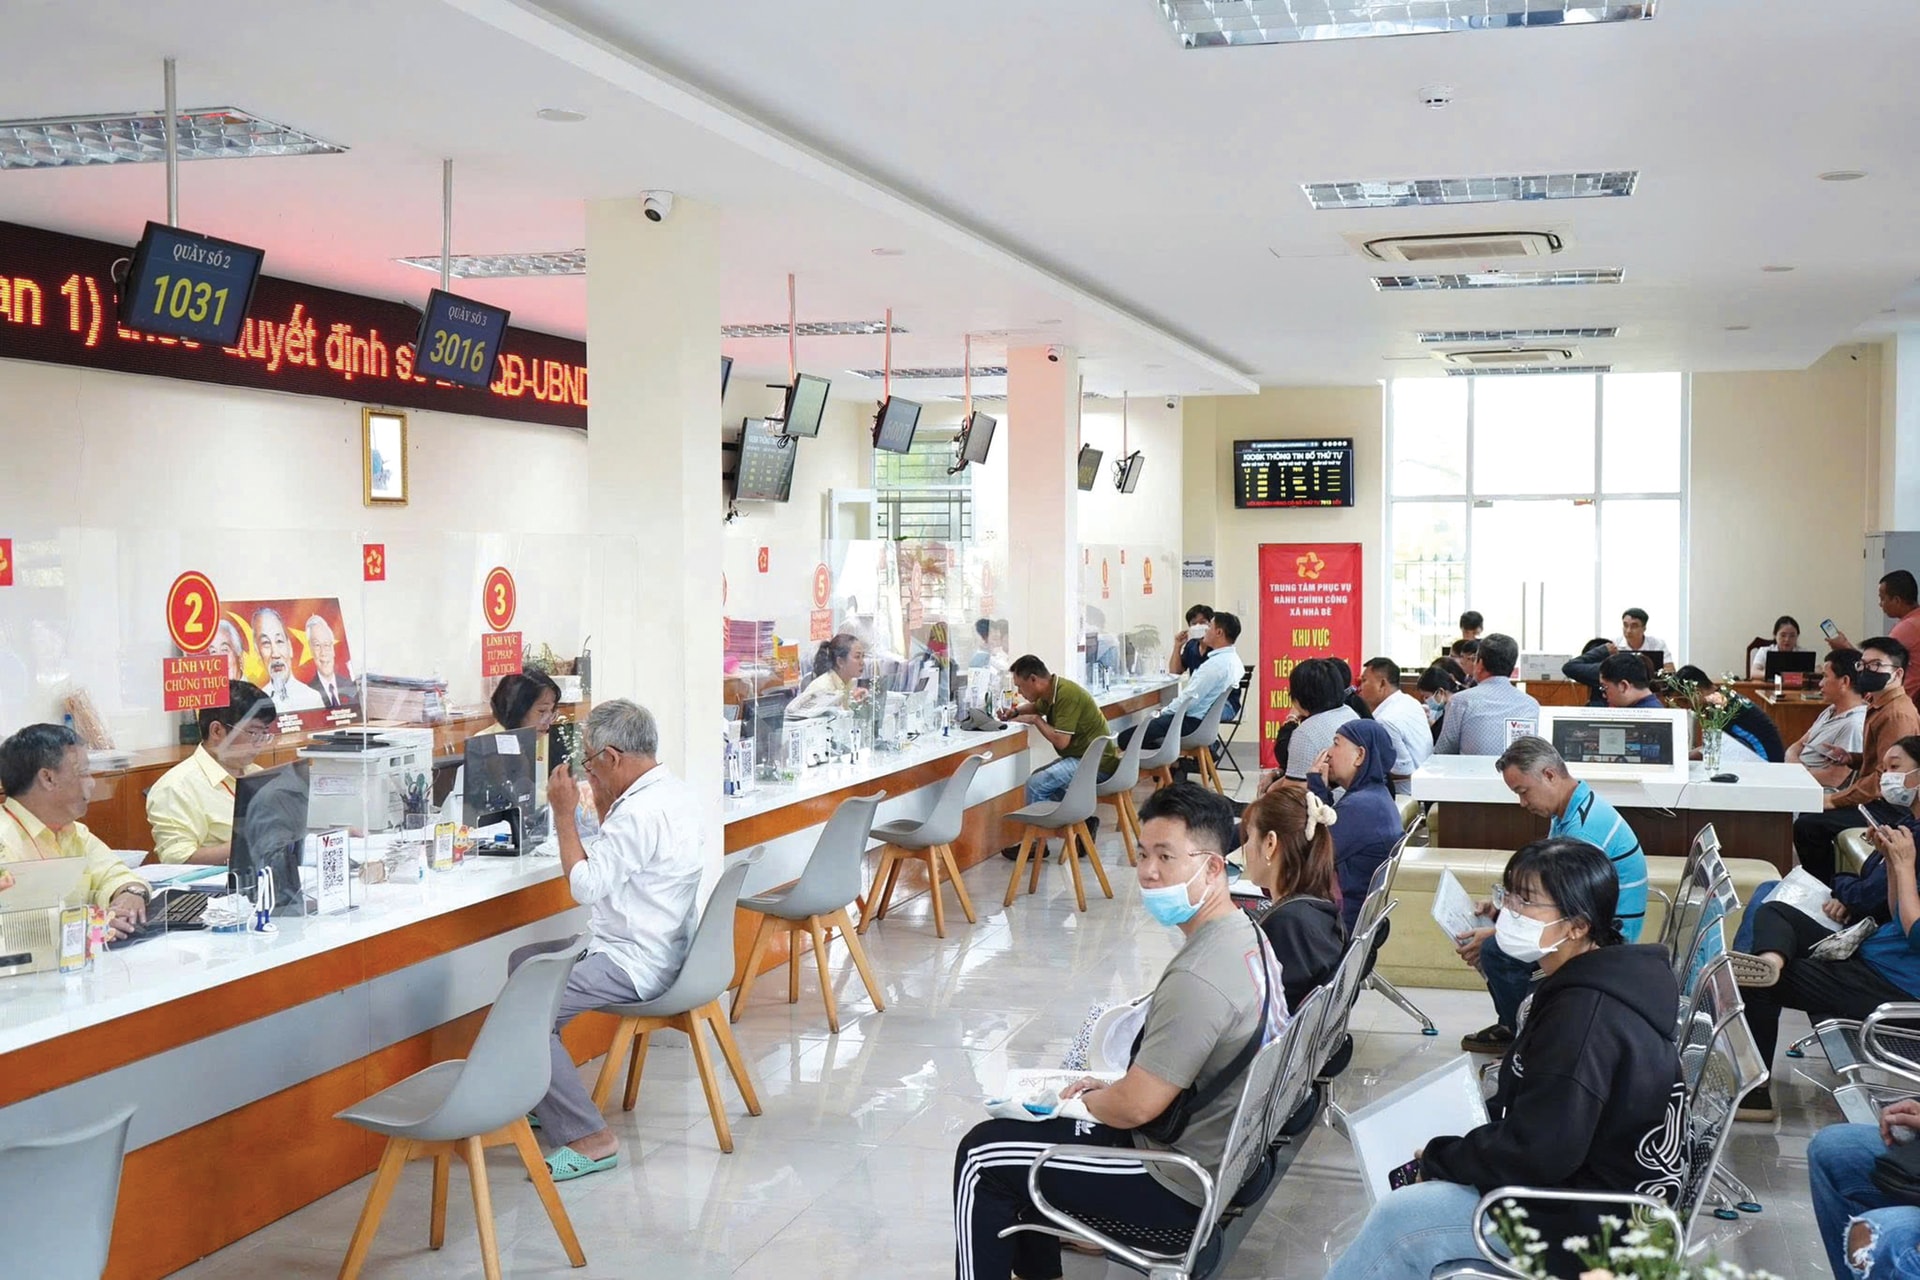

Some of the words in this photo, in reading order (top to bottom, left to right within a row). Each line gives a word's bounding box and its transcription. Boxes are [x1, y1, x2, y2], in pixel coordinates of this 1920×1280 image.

[173, 243, 206, 264] QUẦY
[208, 249, 223, 267] SỐ
[223, 255, 231, 269] 2
[60, 273, 101, 346] 1)
[153, 274, 229, 326] 1031
[448, 305, 470, 322] QUẦY
[470, 309, 481, 325] SỐ
[481, 315, 488, 326] 3
[324, 321, 389, 381] định
[429, 329, 486, 373] 3016
[1266, 452, 1291, 461] THÔNG
[1293, 452, 1304, 460] TIN
[819, 574, 825, 597] 5
[1270, 584, 1297, 592] TRUNG
[1298, 583, 1315, 592] TÂM
[1317, 583, 1339, 593] PHỤC
[1341, 583, 1352, 593] VỤ
[493, 583, 506, 616] 3
[1274, 594, 1296, 604] HÀNH
[1298, 593, 1323, 604] CHÍNH
[1325, 594, 1348, 604] CÔNG
[184, 592, 204, 633] 2
[1292, 629, 1310, 647] KHU
[1312, 627, 1330, 650] VỰC
[171, 659, 197, 674] LĨNH
[199, 658, 221, 674] VỰC
[165, 677, 200, 692] CHỨNG
[202, 675, 228, 690] THỰC
